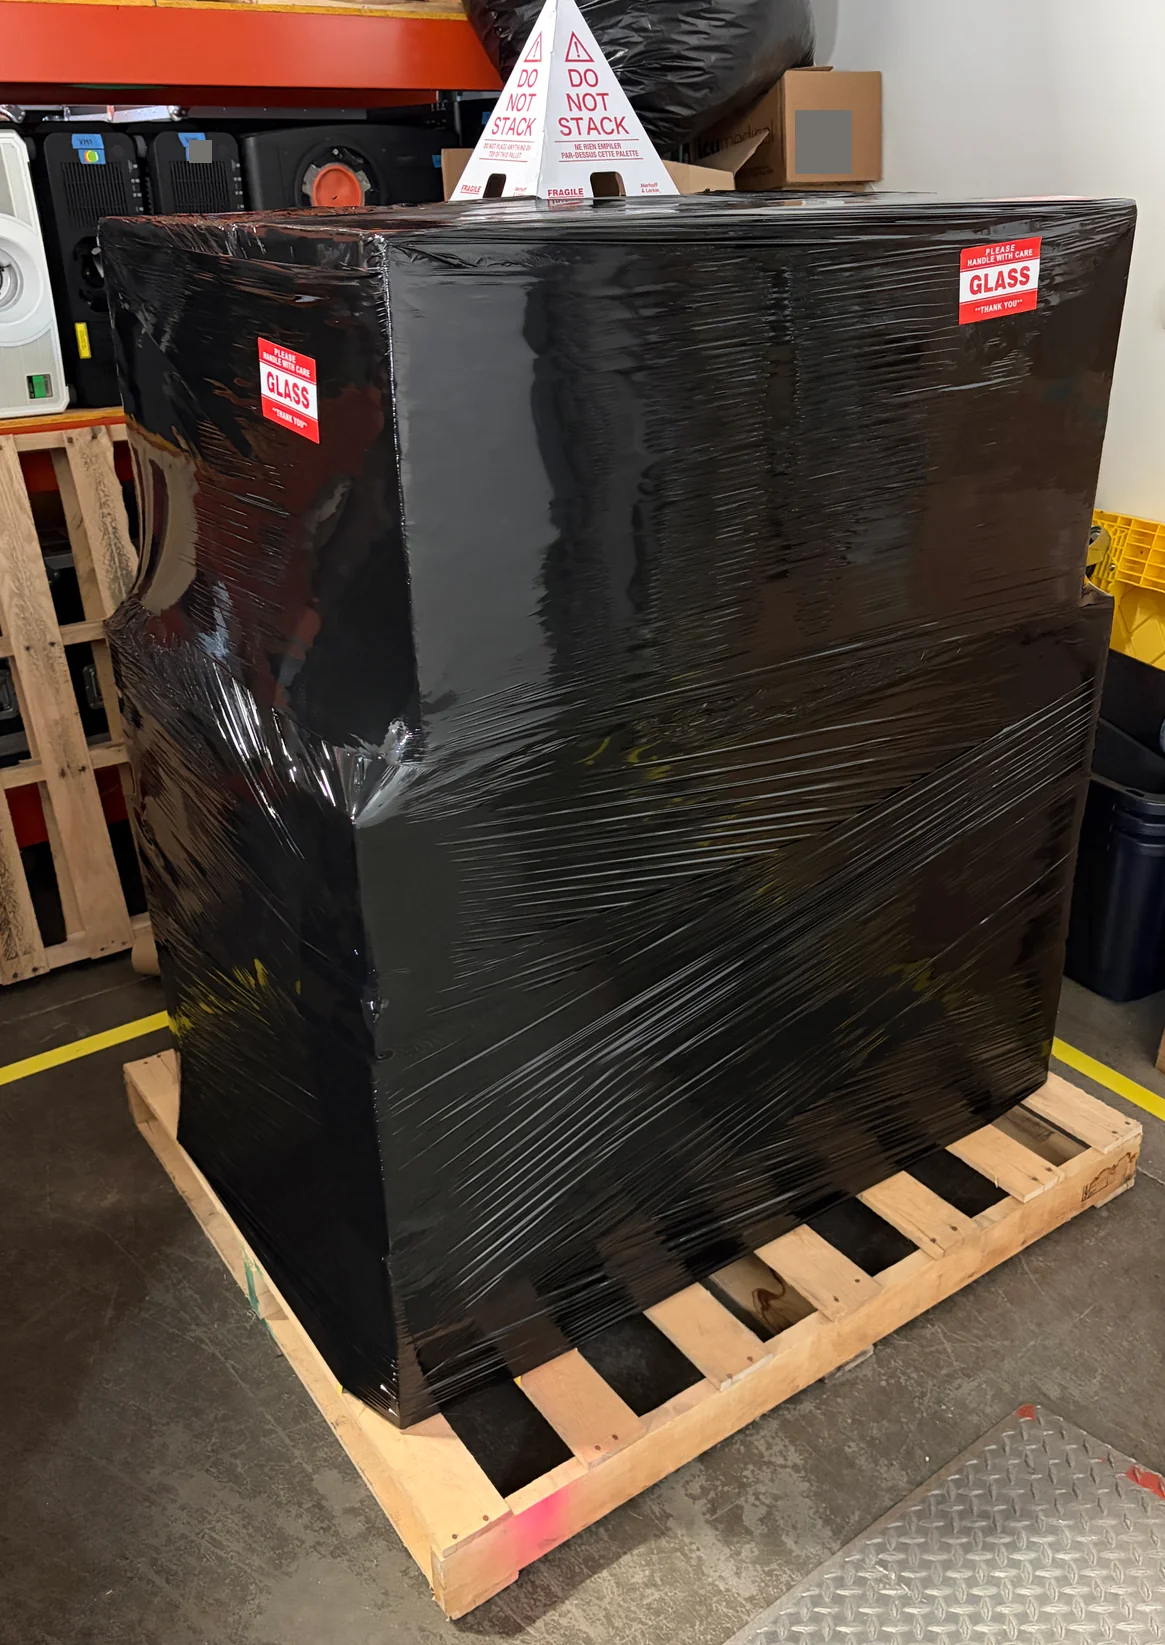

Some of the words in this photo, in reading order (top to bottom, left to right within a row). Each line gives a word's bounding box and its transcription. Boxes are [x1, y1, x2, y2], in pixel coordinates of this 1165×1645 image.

[517, 68, 539, 88] DO
[567, 68, 599, 88] DO
[505, 92, 537, 112] NOT
[565, 92, 609, 112] NOT
[491, 116, 537, 136] STACK
[558, 116, 630, 137] STACK
[561, 151, 597, 159] PAR-DESSUS
[597, 142, 622, 150] EMPILER
[461, 184, 481, 193] FRAGILE
[547, 187, 584, 197] FRAGILE
[967, 255, 995, 267] HANDLE
[996, 252, 1013, 262] WITH
[1014, 248, 1033, 258] CARE
[985, 244, 1015, 256] PLEASE
[969, 265, 1031, 295] GLASS
[262, 351, 282, 366] HANDLE
[281, 359, 295, 372] WITH
[295, 365, 311, 378] CARE
[273, 348, 296, 364] PLEASE
[266, 371, 310, 410] GLASS
